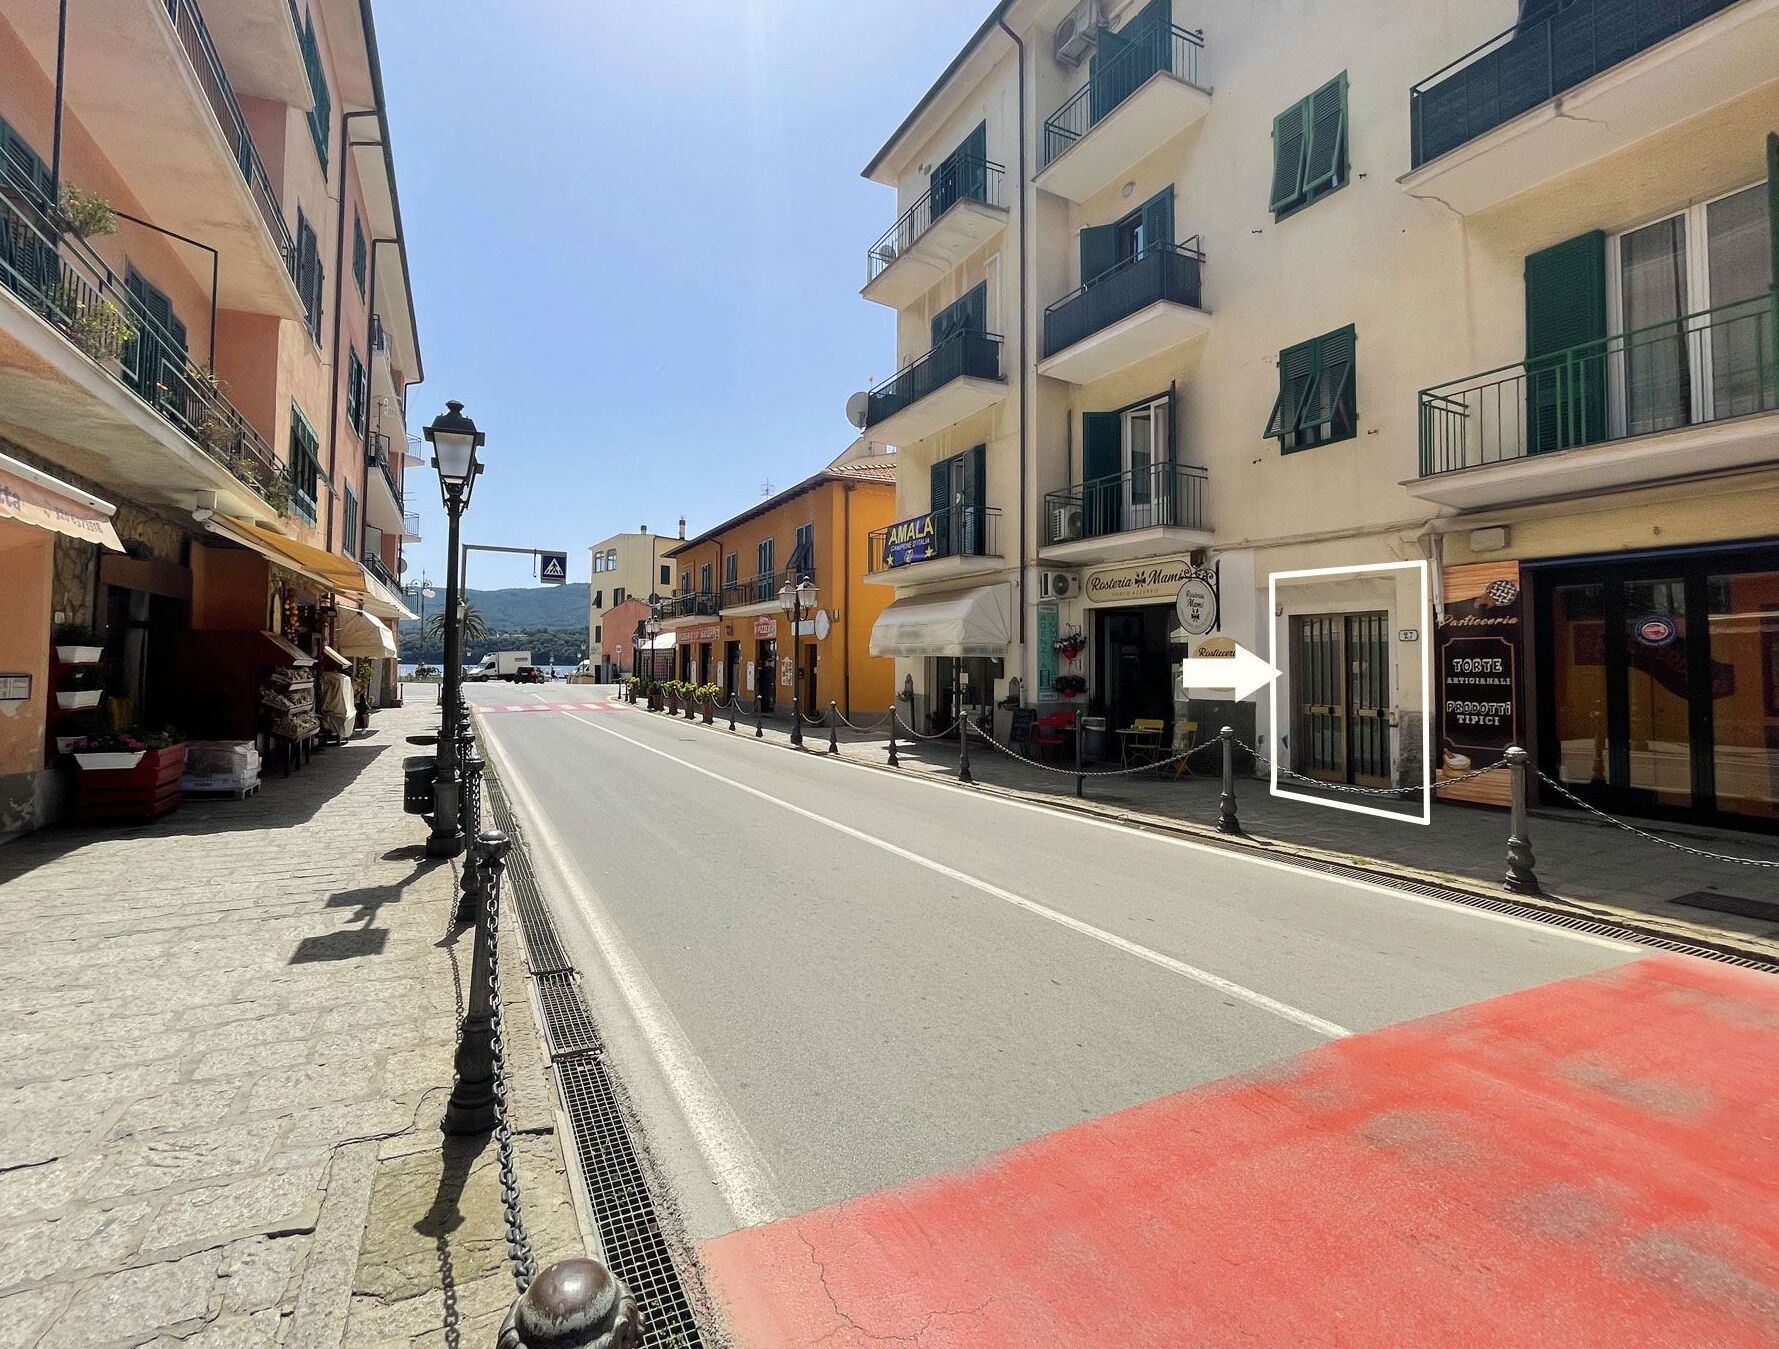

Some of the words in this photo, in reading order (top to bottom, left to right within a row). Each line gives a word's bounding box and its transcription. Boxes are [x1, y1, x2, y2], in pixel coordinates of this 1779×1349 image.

[889, 516, 934, 546] AMALA
[1091, 576, 1133, 592] Rosteria
[1187, 598, 1204, 609] Mami
[1441, 614, 1519, 627] Pasticceria
[1198, 647, 1236, 657] Rosticceri
[1453, 659, 1503, 673] TORTE
[1446, 677, 1511, 685] ARTIGIANALI
[1457, 716, 1500, 725] TIPICI
